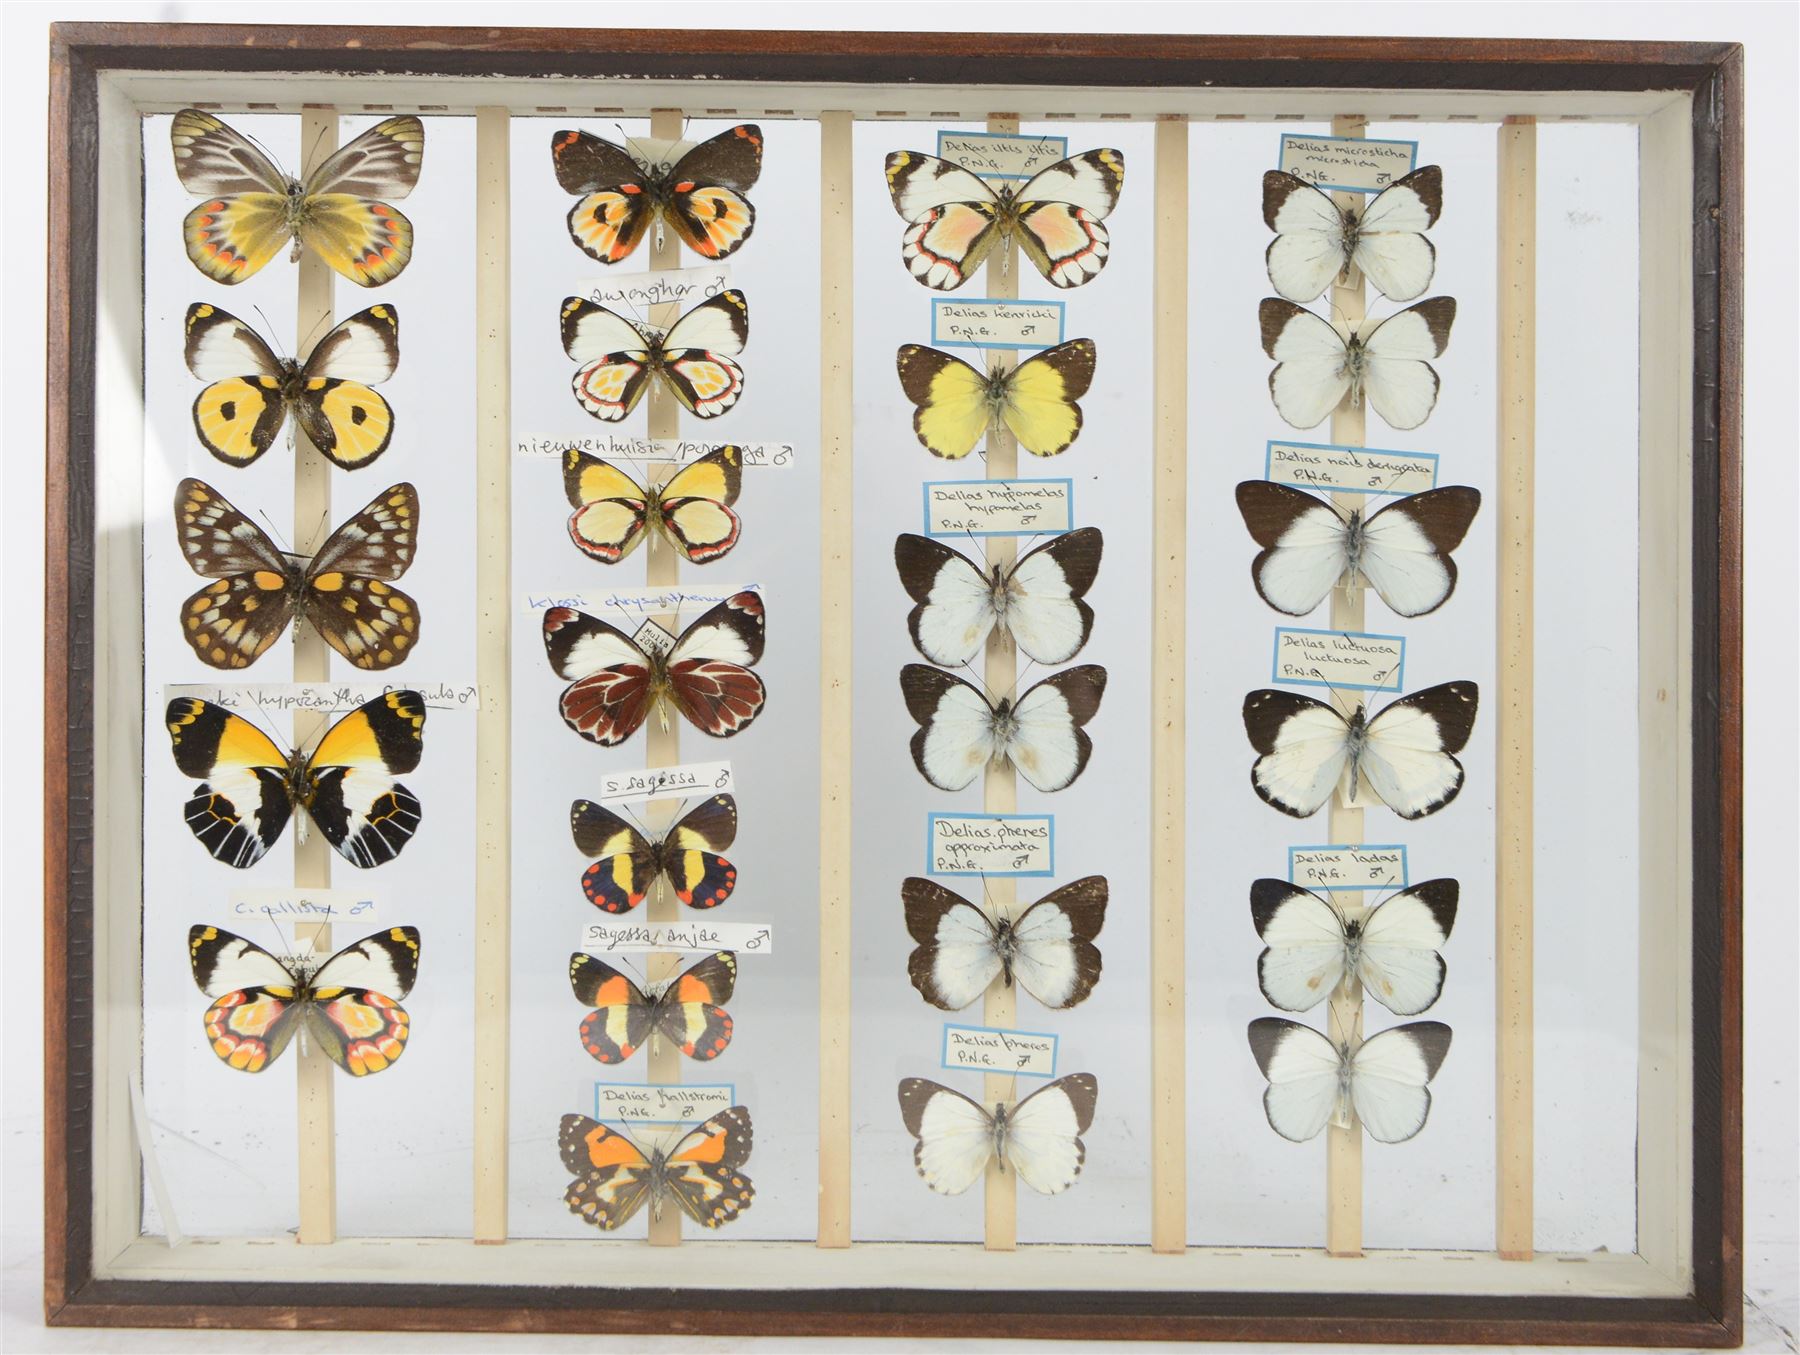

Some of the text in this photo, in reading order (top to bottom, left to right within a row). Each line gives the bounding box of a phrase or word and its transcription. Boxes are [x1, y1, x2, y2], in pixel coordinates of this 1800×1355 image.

[1286, 140, 1330, 152] Delias
[942, 306, 988, 319] Delias
[1275, 450, 1322, 465] Delias
[1283, 635, 1326, 650] Delias
[936, 857, 984, 870] P.N.G.
[1295, 853, 1342, 865] Delias
[951, 1032, 999, 1048] Delias
[603, 1089, 650, 1101] Delias
